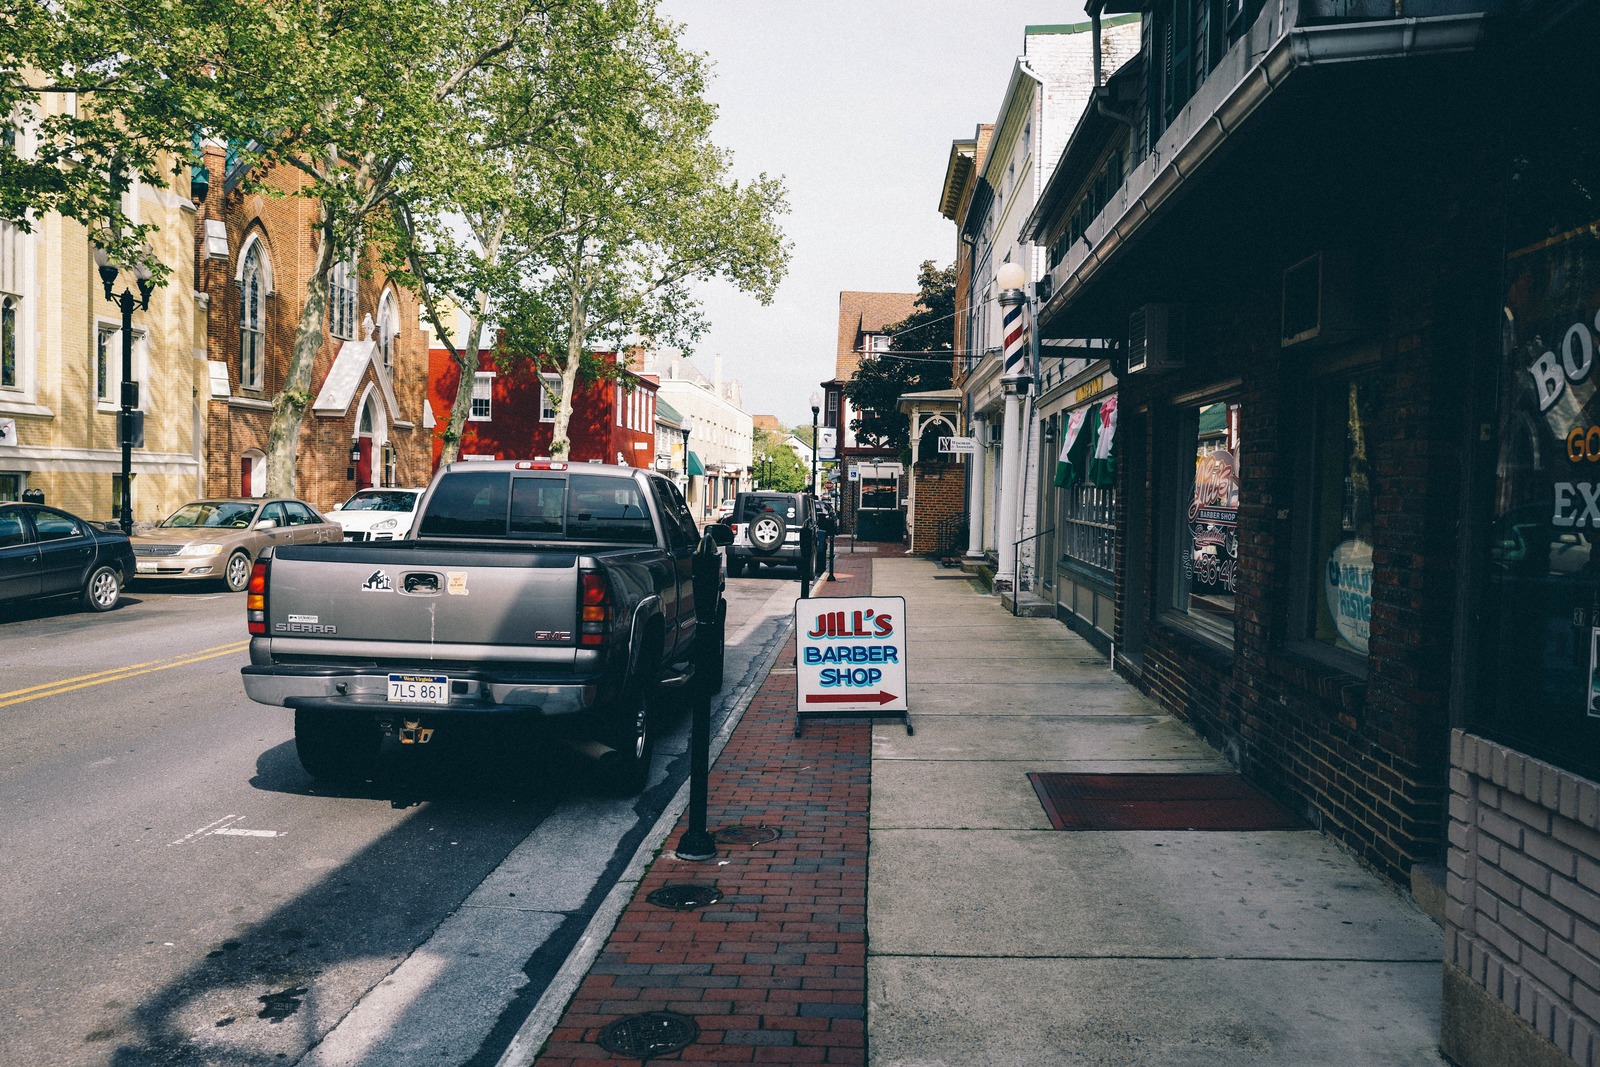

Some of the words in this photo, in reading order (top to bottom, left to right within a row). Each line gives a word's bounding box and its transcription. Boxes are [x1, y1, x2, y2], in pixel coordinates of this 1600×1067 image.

[1528, 307, 1600, 412] BO
[1567, 425, 1600, 463] GO
[1552, 482, 1600, 527] EX
[1199, 510, 1221, 519] BARBER
[1220, 512, 1236, 521] SHOP
[275, 622, 337, 635] SIERRA
[807, 608, 893, 640] JILL'S
[534, 630, 571, 641] GMC
[803, 646, 899, 665] BARBER
[820, 667, 882, 688] SHOP
[391, 683, 416, 698] 7LS
[420, 684, 442, 699] 861
